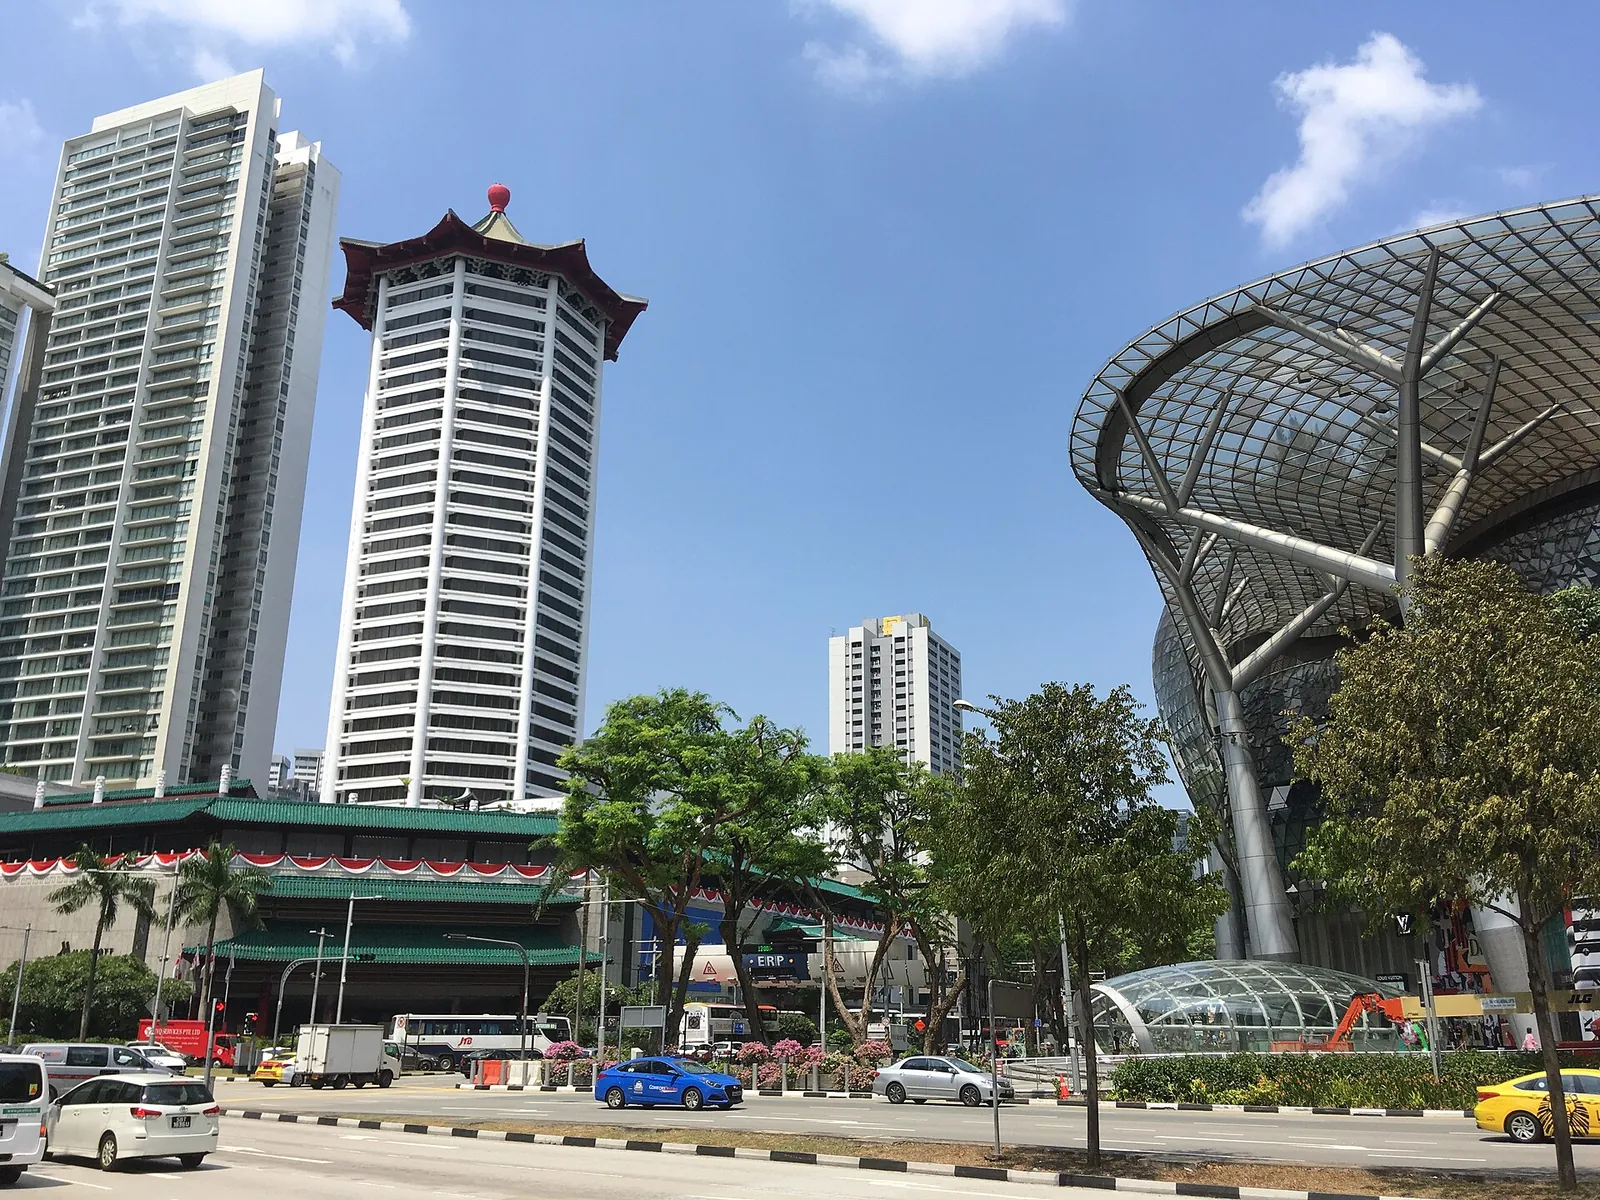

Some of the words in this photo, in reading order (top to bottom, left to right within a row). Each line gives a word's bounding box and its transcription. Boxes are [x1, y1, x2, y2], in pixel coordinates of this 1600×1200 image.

[757, 955, 784, 967] ERP
[1567, 994, 1592, 1004] JLG
[192, 1028, 201, 1036] LTD
[458, 1037, 473, 1046] JTB
